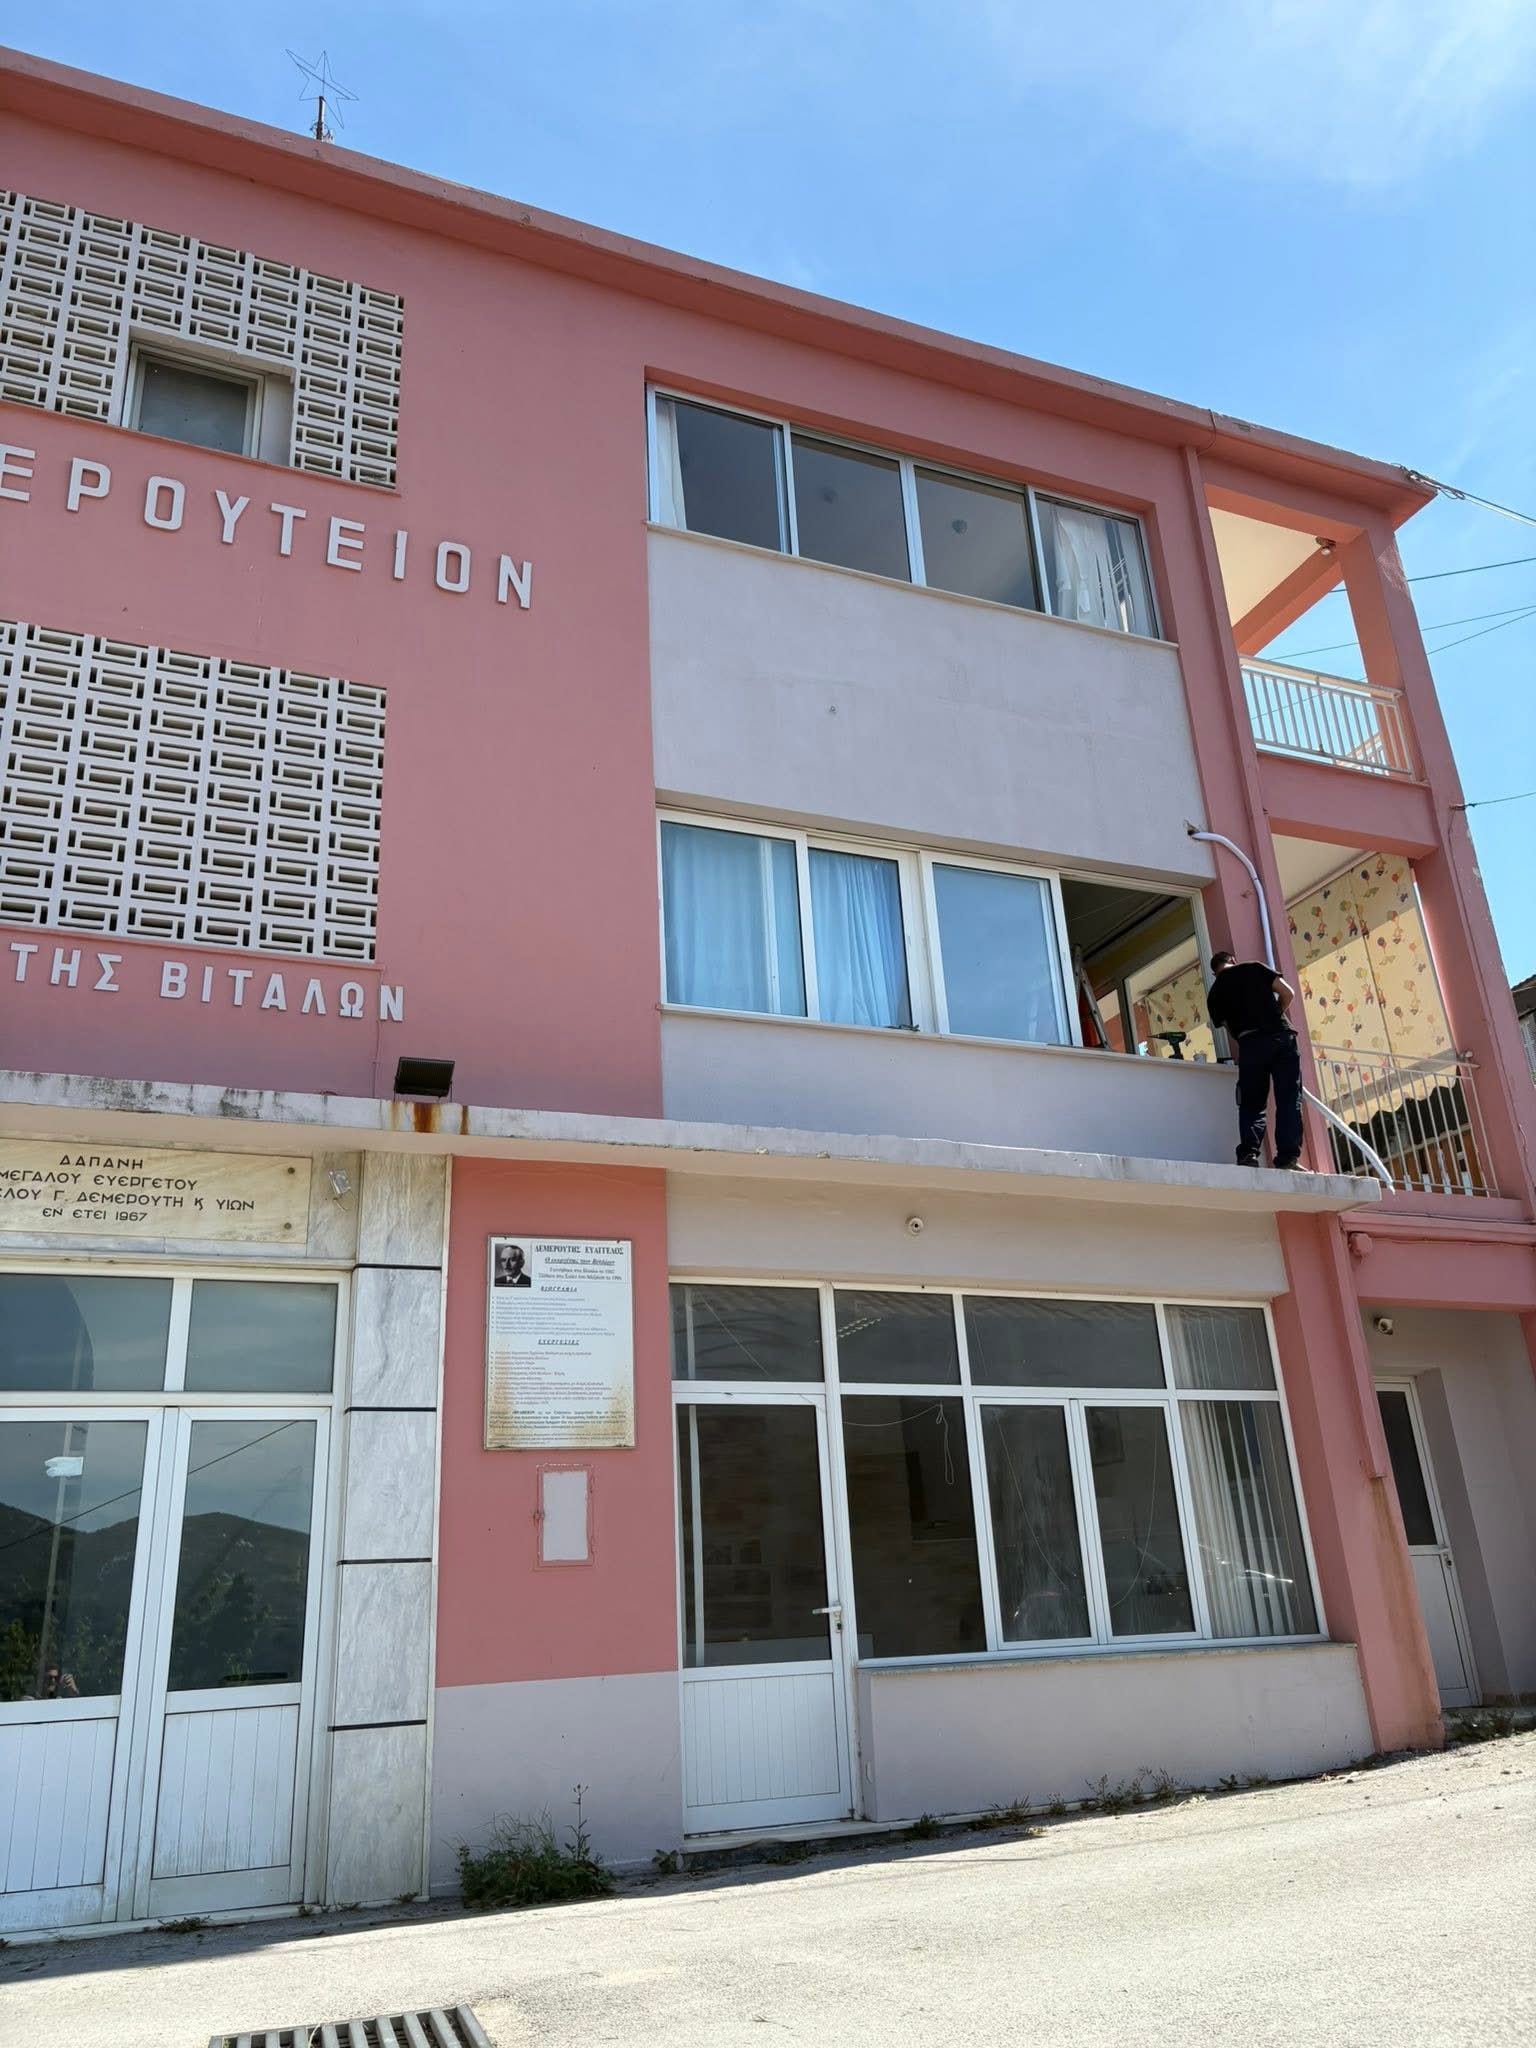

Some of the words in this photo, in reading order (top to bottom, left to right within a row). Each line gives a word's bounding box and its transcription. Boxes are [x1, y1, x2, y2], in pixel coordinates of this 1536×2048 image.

[0, 443, 533, 609] ΕΡΟΥΤΕΙΟΝ
[9, 942, 123, 992] ΤΗΣ
[159, 960, 404, 1022] ΒΙΤΑΛΩΝ
[59, 1154, 144, 1170] ΔΑΠΑΝΗ
[93, 1174, 198, 1191] ΕΥΕΡΓΕΤΟΥ
[76, 1191, 184, 1208] ΔΕΜΕΡΟΥΤΗ
[215, 1199, 255, 1211] ΥΙΩΝ
[42, 1207, 64, 1218] ΕΝ
[72, 1209, 107, 1220] ΕΤΕΙ
[115, 1211, 148, 1222] 1967
